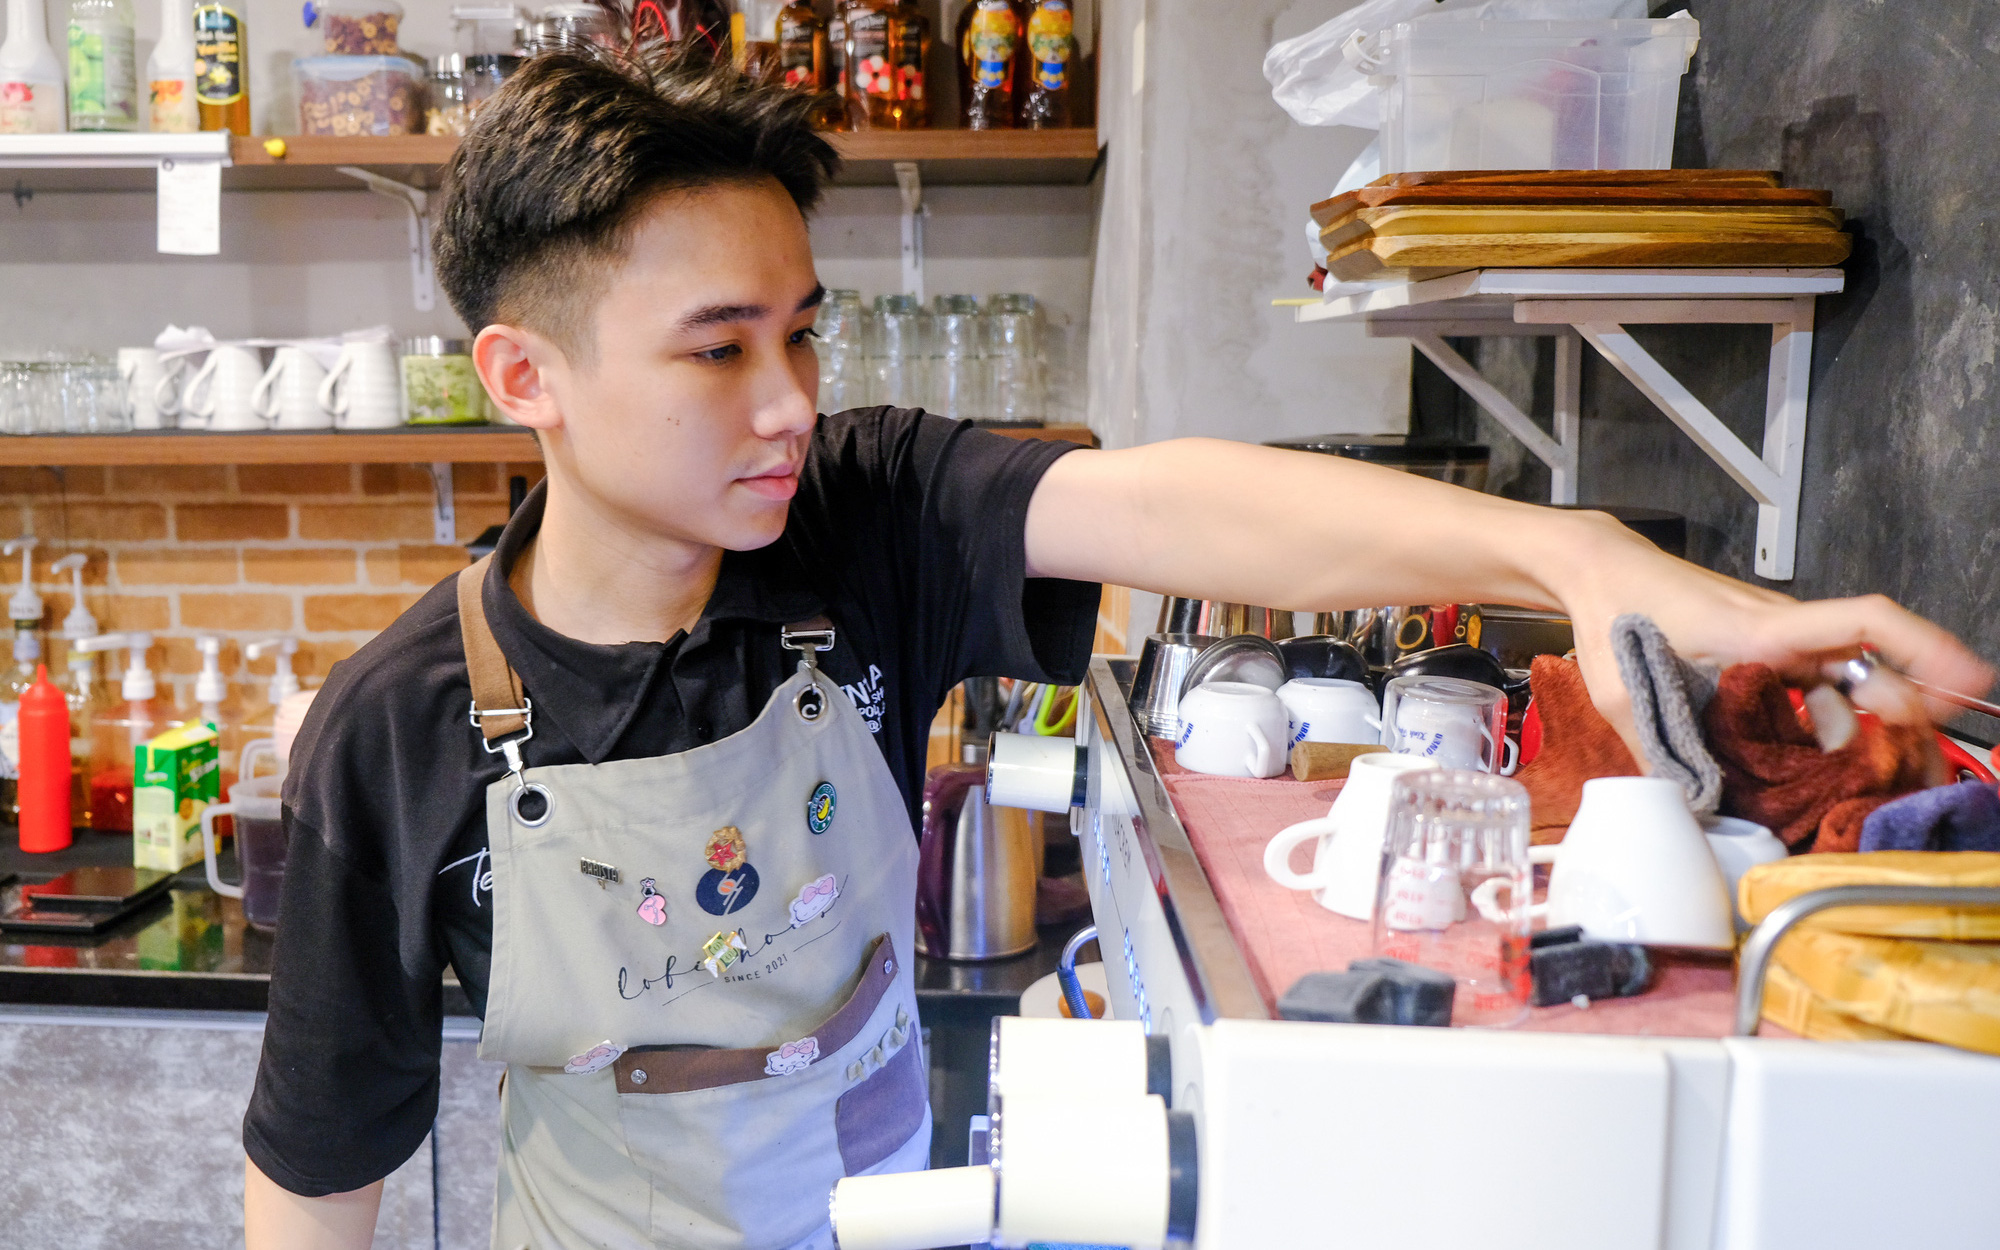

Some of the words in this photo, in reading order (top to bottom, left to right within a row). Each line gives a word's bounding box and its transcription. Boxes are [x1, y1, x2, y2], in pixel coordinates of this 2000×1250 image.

[1295, 721, 1310, 742] UBND
[1426, 733, 1443, 755] UBND
[724, 970, 761, 984] SINCE
[765, 953, 789, 975] 2021
